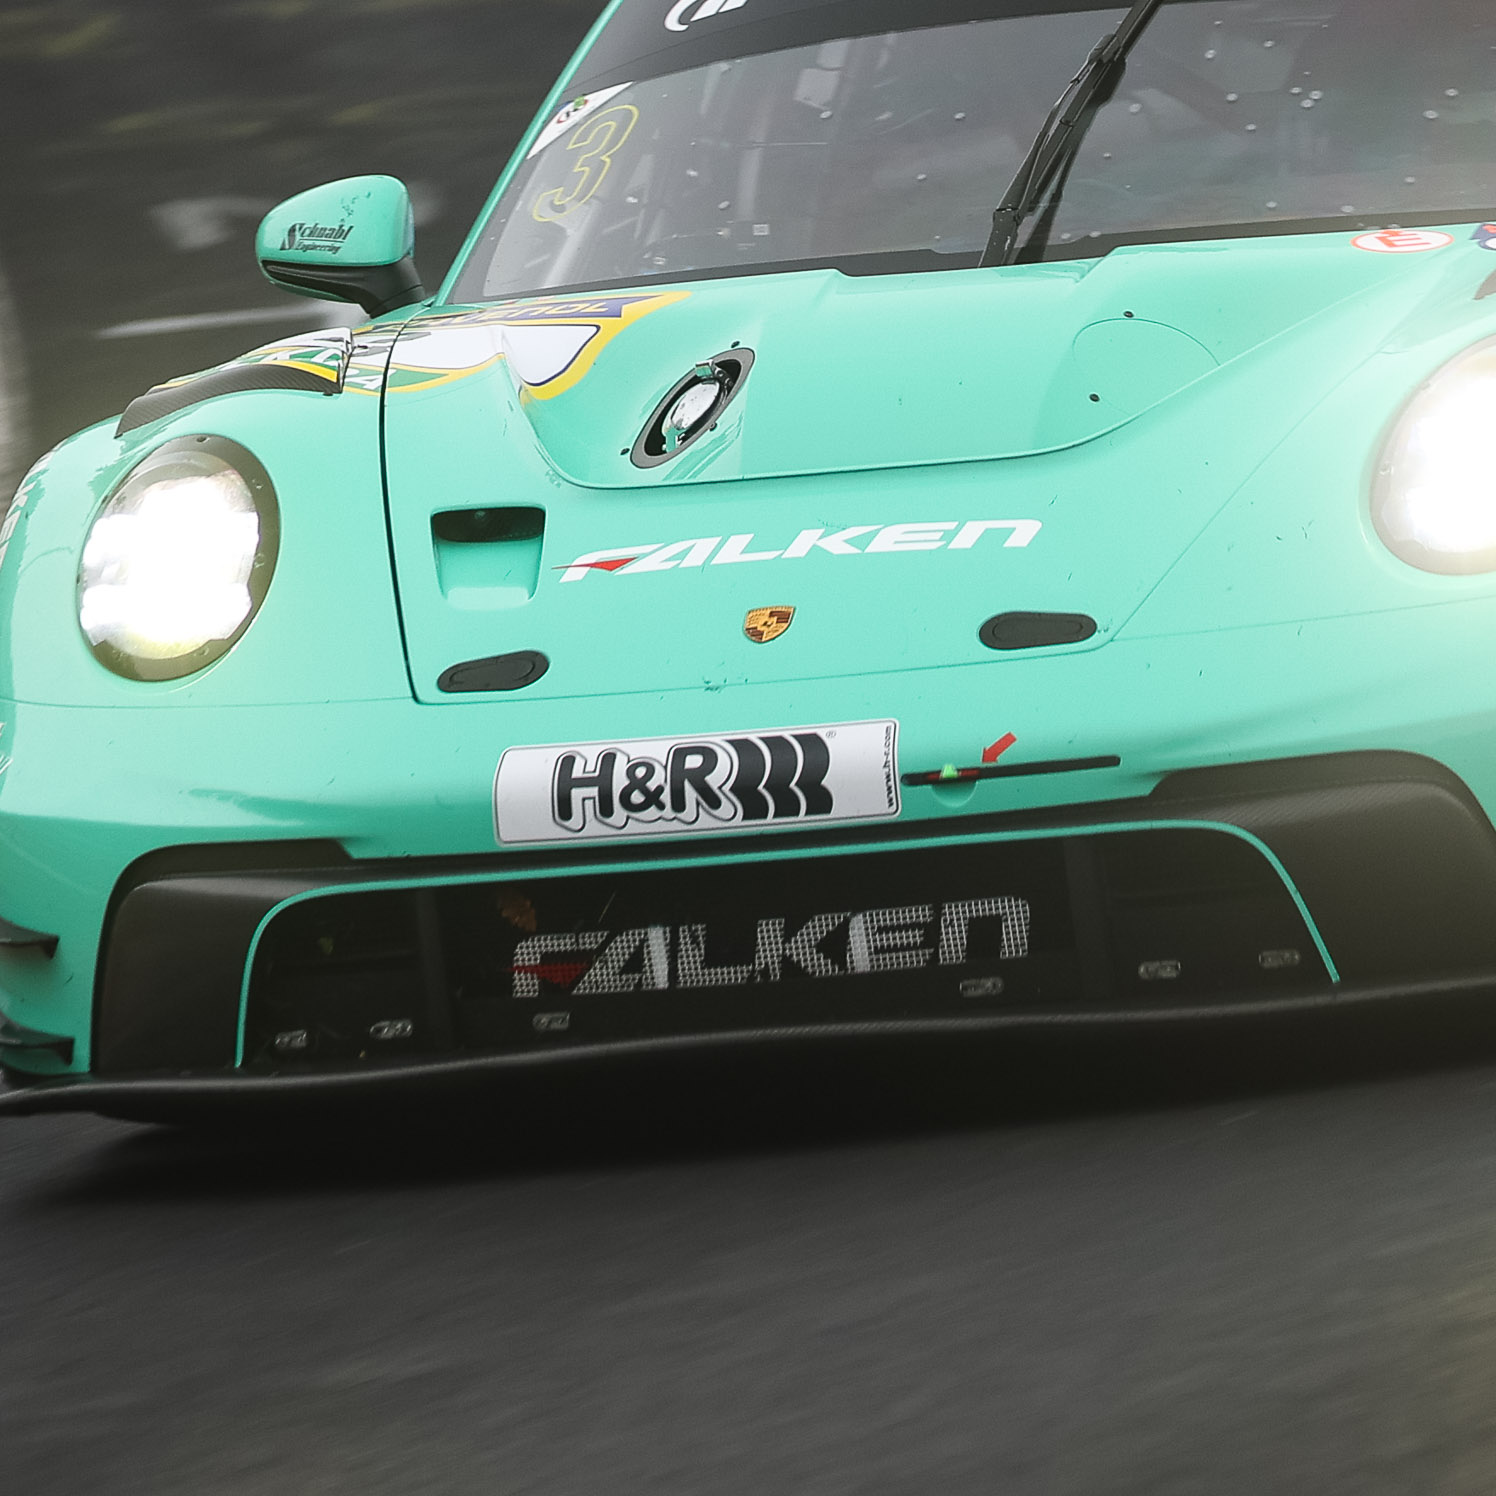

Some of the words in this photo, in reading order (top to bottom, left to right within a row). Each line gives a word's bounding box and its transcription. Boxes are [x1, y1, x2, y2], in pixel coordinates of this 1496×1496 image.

[532, 104, 640, 223] 3
[551, 518, 1043, 584] FALKEN
[552, 741, 737, 832] H&R
[508, 896, 1031, 999] FALKEN
